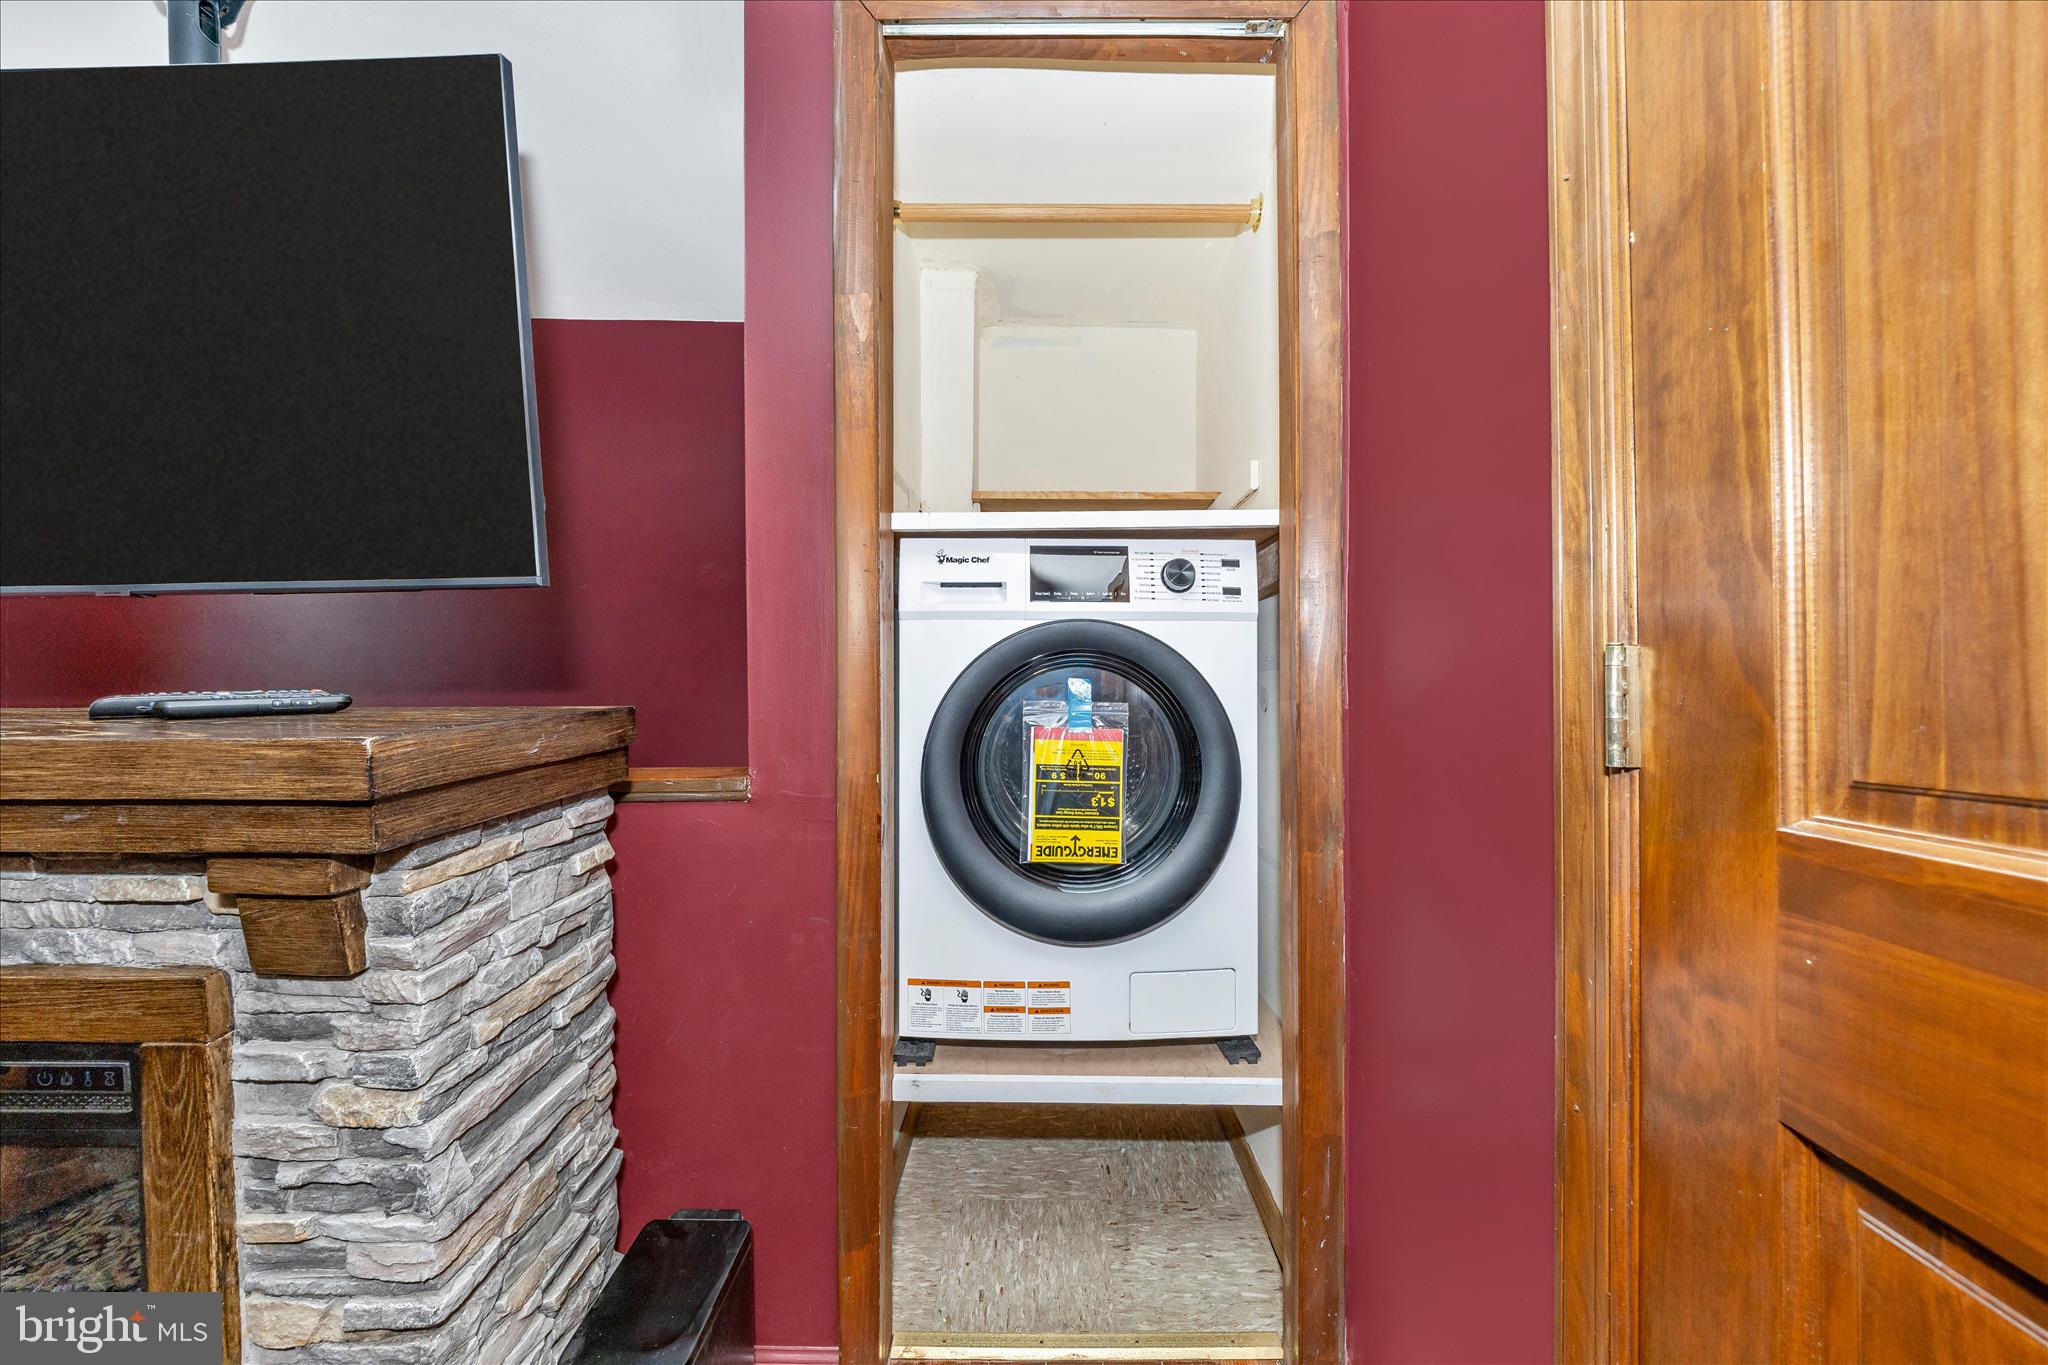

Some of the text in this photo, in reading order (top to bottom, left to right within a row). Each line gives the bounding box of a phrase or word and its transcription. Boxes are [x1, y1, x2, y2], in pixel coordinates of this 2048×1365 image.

[945, 556, 969, 564] Magic
[1091, 797, 1116, 807] $13
[1035, 845, 1118, 858] ENERGYGUIDE
